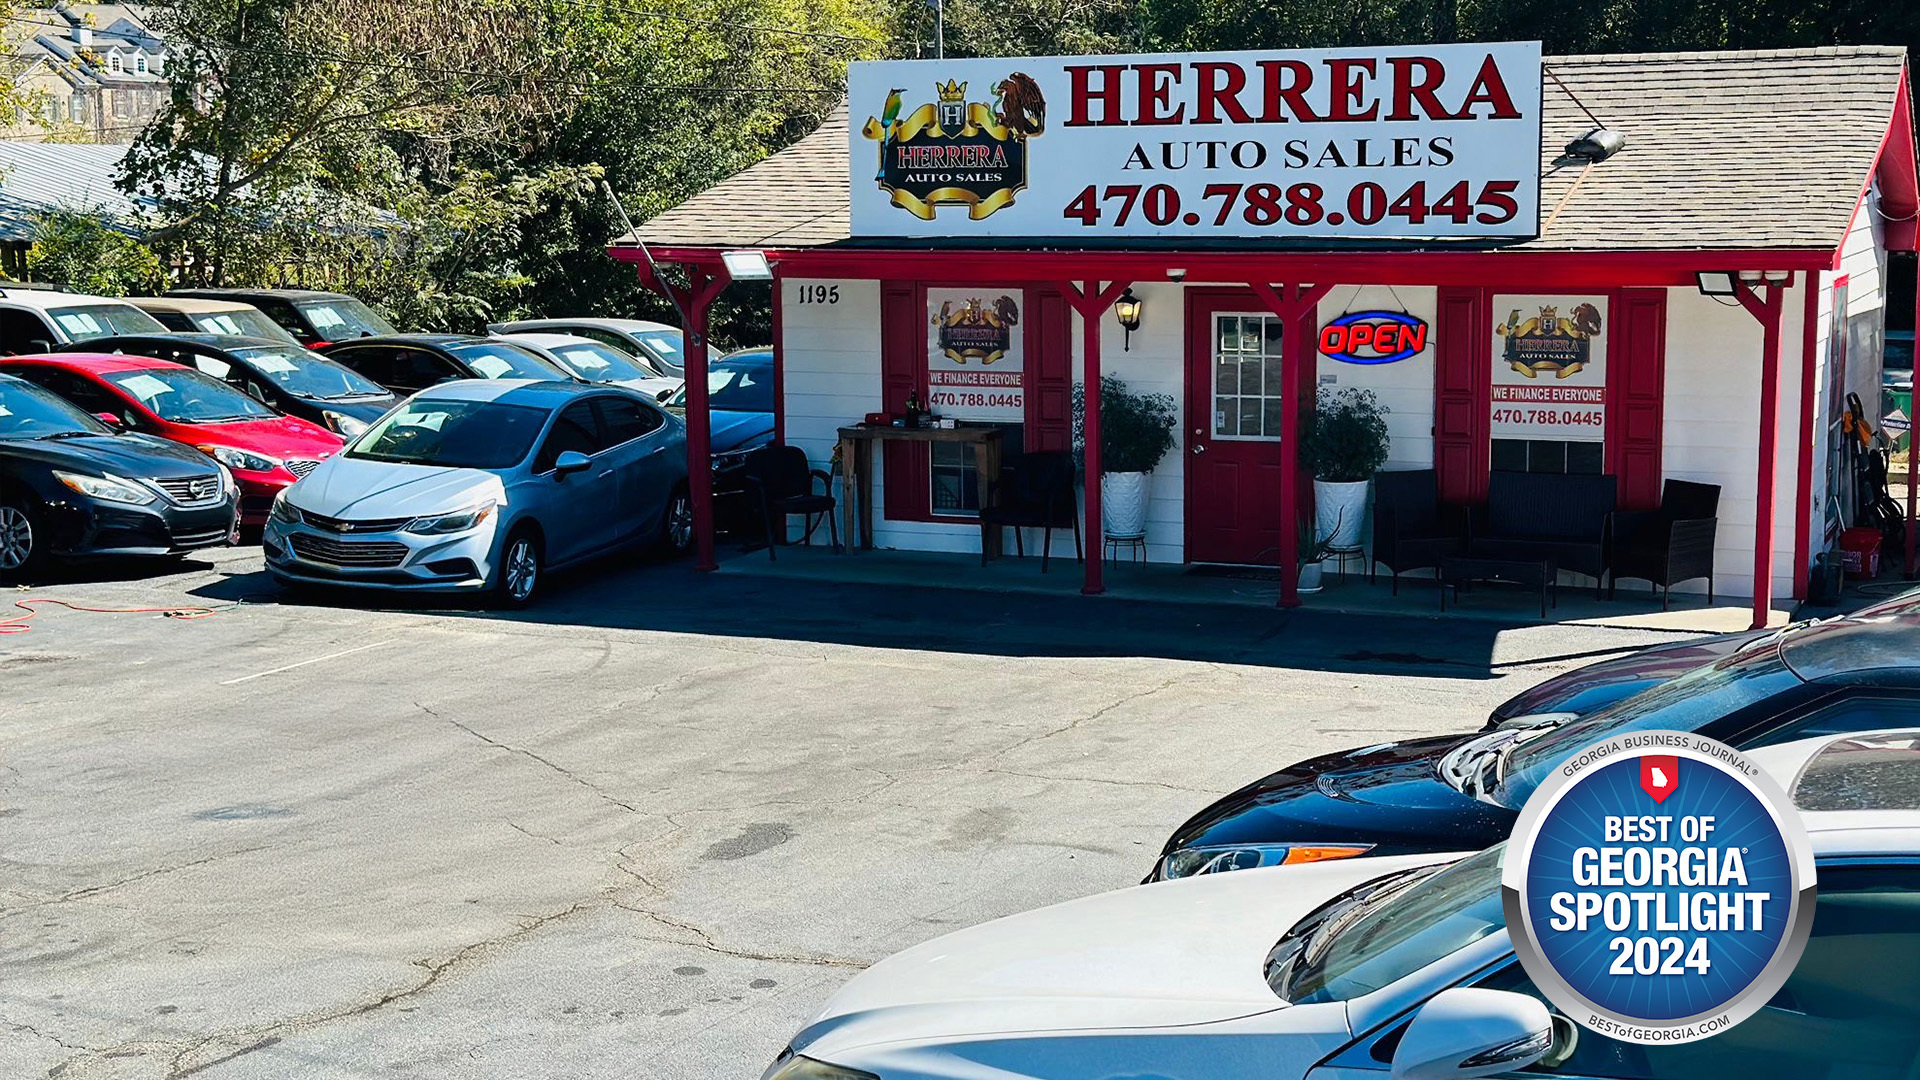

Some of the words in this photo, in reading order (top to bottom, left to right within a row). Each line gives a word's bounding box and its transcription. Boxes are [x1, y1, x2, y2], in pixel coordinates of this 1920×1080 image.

[1063, 53, 1523, 127] HERRERA
[943, 106, 961, 126] H
[897, 145, 1009, 169] HERRERA
[1121, 140, 1267, 170] AUTO
[1284, 137, 1455, 169] SALES
[905, 173, 952, 183] AUTO
[956, 173, 1003, 182] SALES
[1063, 180, 1521, 227] 470.788.0445
[799, 285, 840, 304] 1195
[1543, 320, 1553, 330] H
[1319, 323, 1426, 354] OPEN
[1515, 339, 1580, 352] HERRERA
[930, 372, 943, 384] WE
[944, 372, 978, 385] FINANCE
[980, 374, 1022, 386] EVERYONE
[930, 392, 1023, 408] 470.788.0445
[1493, 387, 1507, 399] WE
[1509, 388, 1550, 400] FINANCE
[1552, 389, 1603, 402] EVERYONE
[1492, 409, 1603, 426] 470.788.0445
